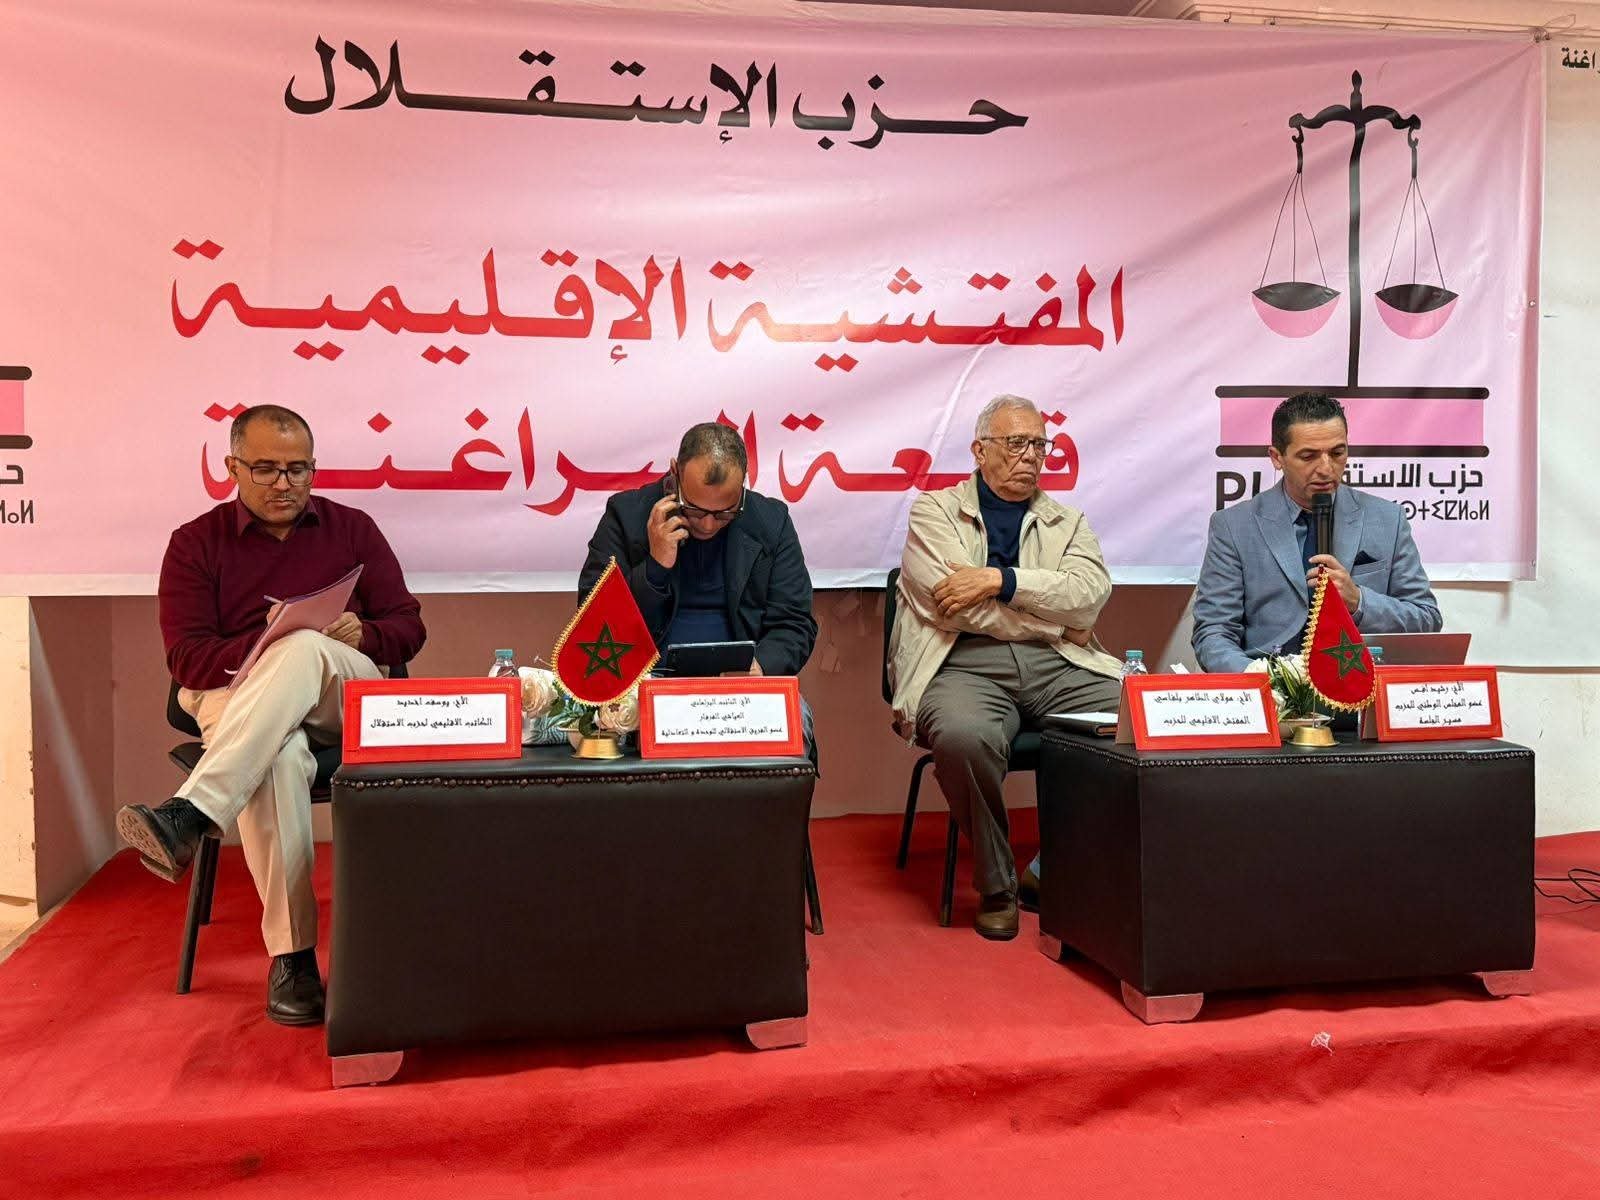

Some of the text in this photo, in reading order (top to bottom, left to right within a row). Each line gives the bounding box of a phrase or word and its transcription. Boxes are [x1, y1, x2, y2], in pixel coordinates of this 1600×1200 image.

[1561, 47, 1600, 73] اغنة
[284, 34, 1029, 149] حزب الإستقلال
[171, 238, 1124, 373] المفتشية الإقليمية
[202, 402, 1079, 516] قعة اراغنة
[1341, 463, 1483, 494] حزب الاستق
[425, 699, 449, 707] يوسف
[1185, 693, 1209, 704] الطاهر
[1212, 693, 1233, 704] مولاي
[1395, 698, 1482, 711] عضو المجلس الوطني للحزب
[371, 718, 404, 728] الاستقلال
[407, 718, 428, 728] لحزب
[465, 717, 492, 728] الكاتب
[1164, 715, 1186, 726] للحزب
[1223, 716, 1250, 726] المفتش
